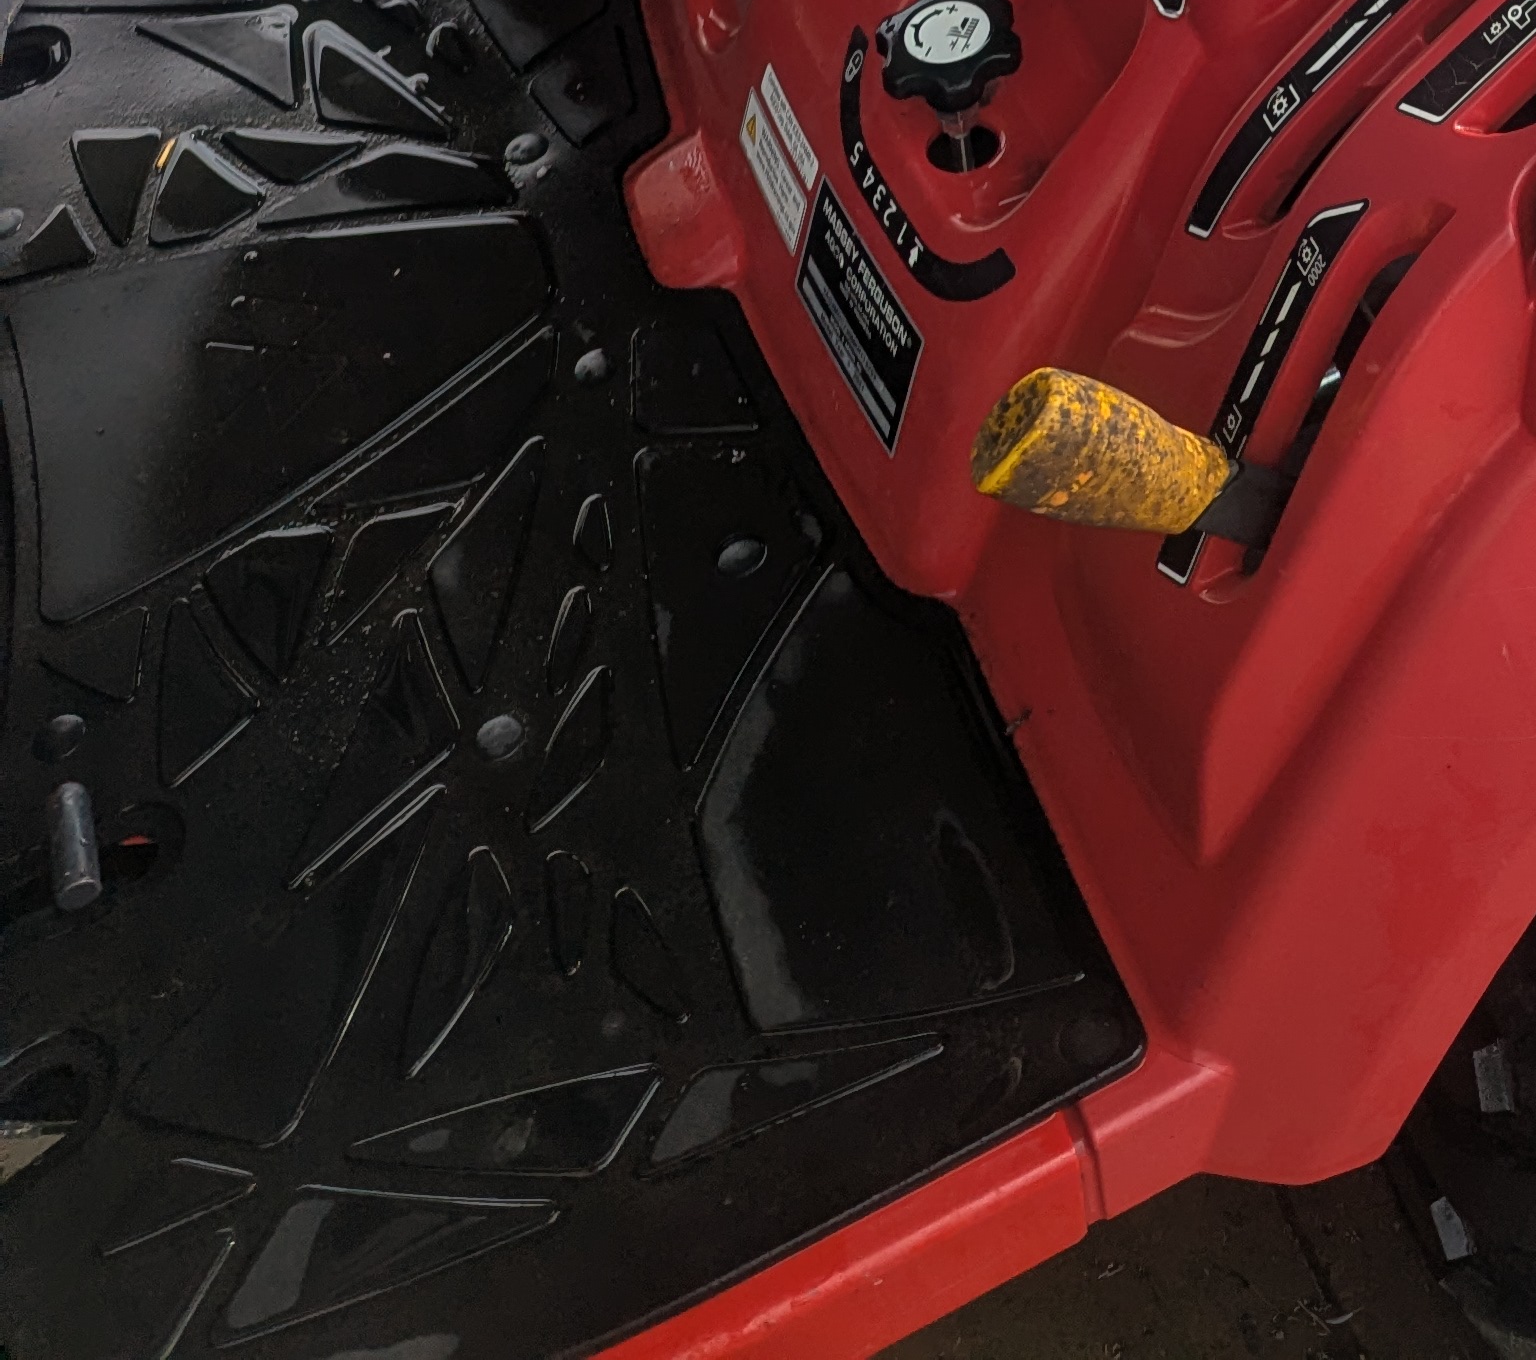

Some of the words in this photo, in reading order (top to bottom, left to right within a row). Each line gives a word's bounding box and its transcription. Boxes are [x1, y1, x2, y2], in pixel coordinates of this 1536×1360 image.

[850, 141, 864, 167] 5
[862, 165, 875, 189] 4
[872, 184, 886, 210] 3
[883, 198, 897, 227] 2
[823, 197, 859, 264] MASSEY
[897, 221, 908, 245] 1
[1307, 254, 1326, 286] 2000
[846, 265, 897, 358] CORPORATION
